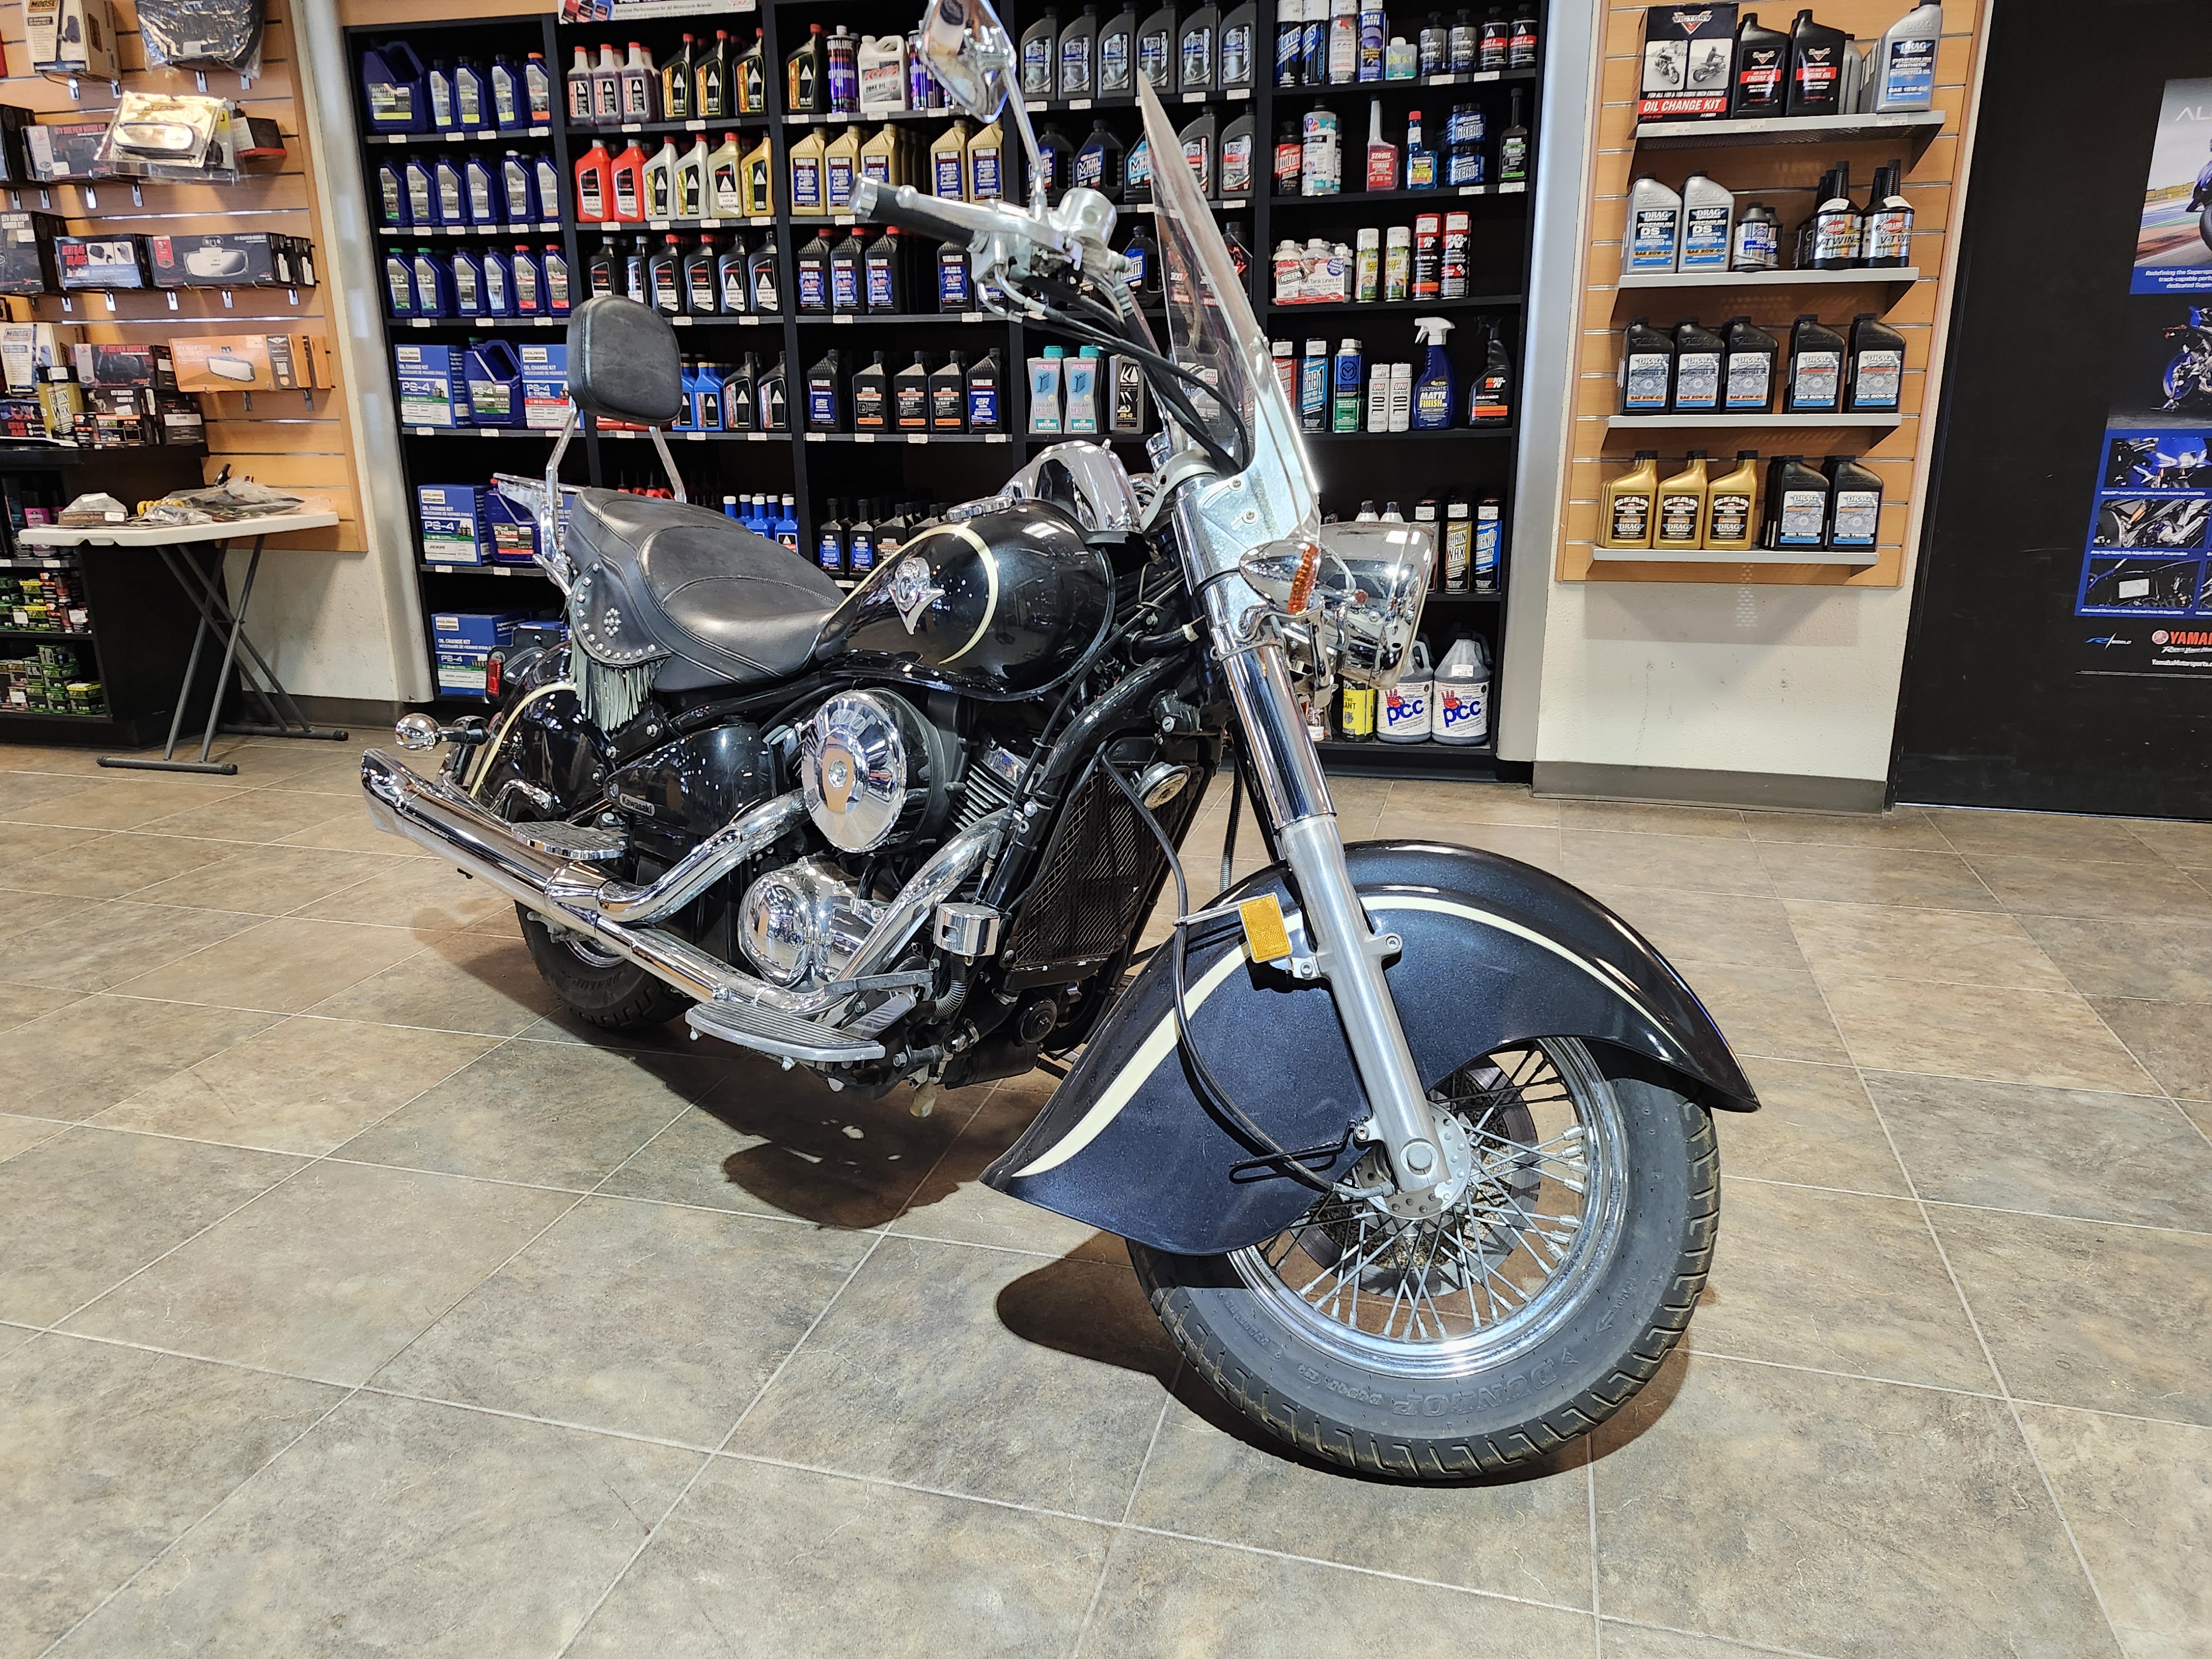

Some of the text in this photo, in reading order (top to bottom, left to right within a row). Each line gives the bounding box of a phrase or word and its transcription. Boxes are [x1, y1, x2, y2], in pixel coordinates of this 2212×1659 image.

[1277, 28, 1301, 53] Plexus
[1900, 42, 1927, 51] DRAG
[1892, 56, 1932, 65] PREMIUM
[1644, 99, 1723, 112] OIL CHANGE KIT
[1305, 118, 1314, 133] VP
[1457, 123, 1484, 139] GREASE
[1451, 164, 1479, 181] GREASE
[1645, 211, 1669, 219] DRAG
[1696, 208, 1721, 217] DRAG
[1825, 223, 1846, 232] RED LINE
[1281, 271, 1302, 283] KREEM
[1173, 294, 1190, 302] MOTUL
[6, 330, 30, 338] MOOSE
[1806, 356, 1831, 364] DRAG
[1867, 354, 1892, 362] DRAG
[1303, 366, 1324, 395] FAB1
[401, 382, 430, 392] PS-4
[526, 384, 550, 392] PS-4
[1372, 383, 1386, 391] UNI
[1420, 392, 1447, 400] MATTE
[1372, 396, 1385, 416] OIL
[1393, 396, 1408, 415] OIL
[1420, 399, 1443, 408] FINISH
[1614, 496, 1649, 507] GEAR
[1663, 496, 1698, 507] GEAR
[1713, 496, 1749, 507] GEAR
[424, 520, 455, 531] PS-4
[1447, 530, 1467, 546] CHAIN
[1448, 544, 1467, 562] WAX
[1386, 700, 1425, 727] pcc
[1443, 701, 1481, 728] pcc
[622, 795, 653, 815] Kawasaki
[1392, 1359, 1558, 1418] DUNLOP
